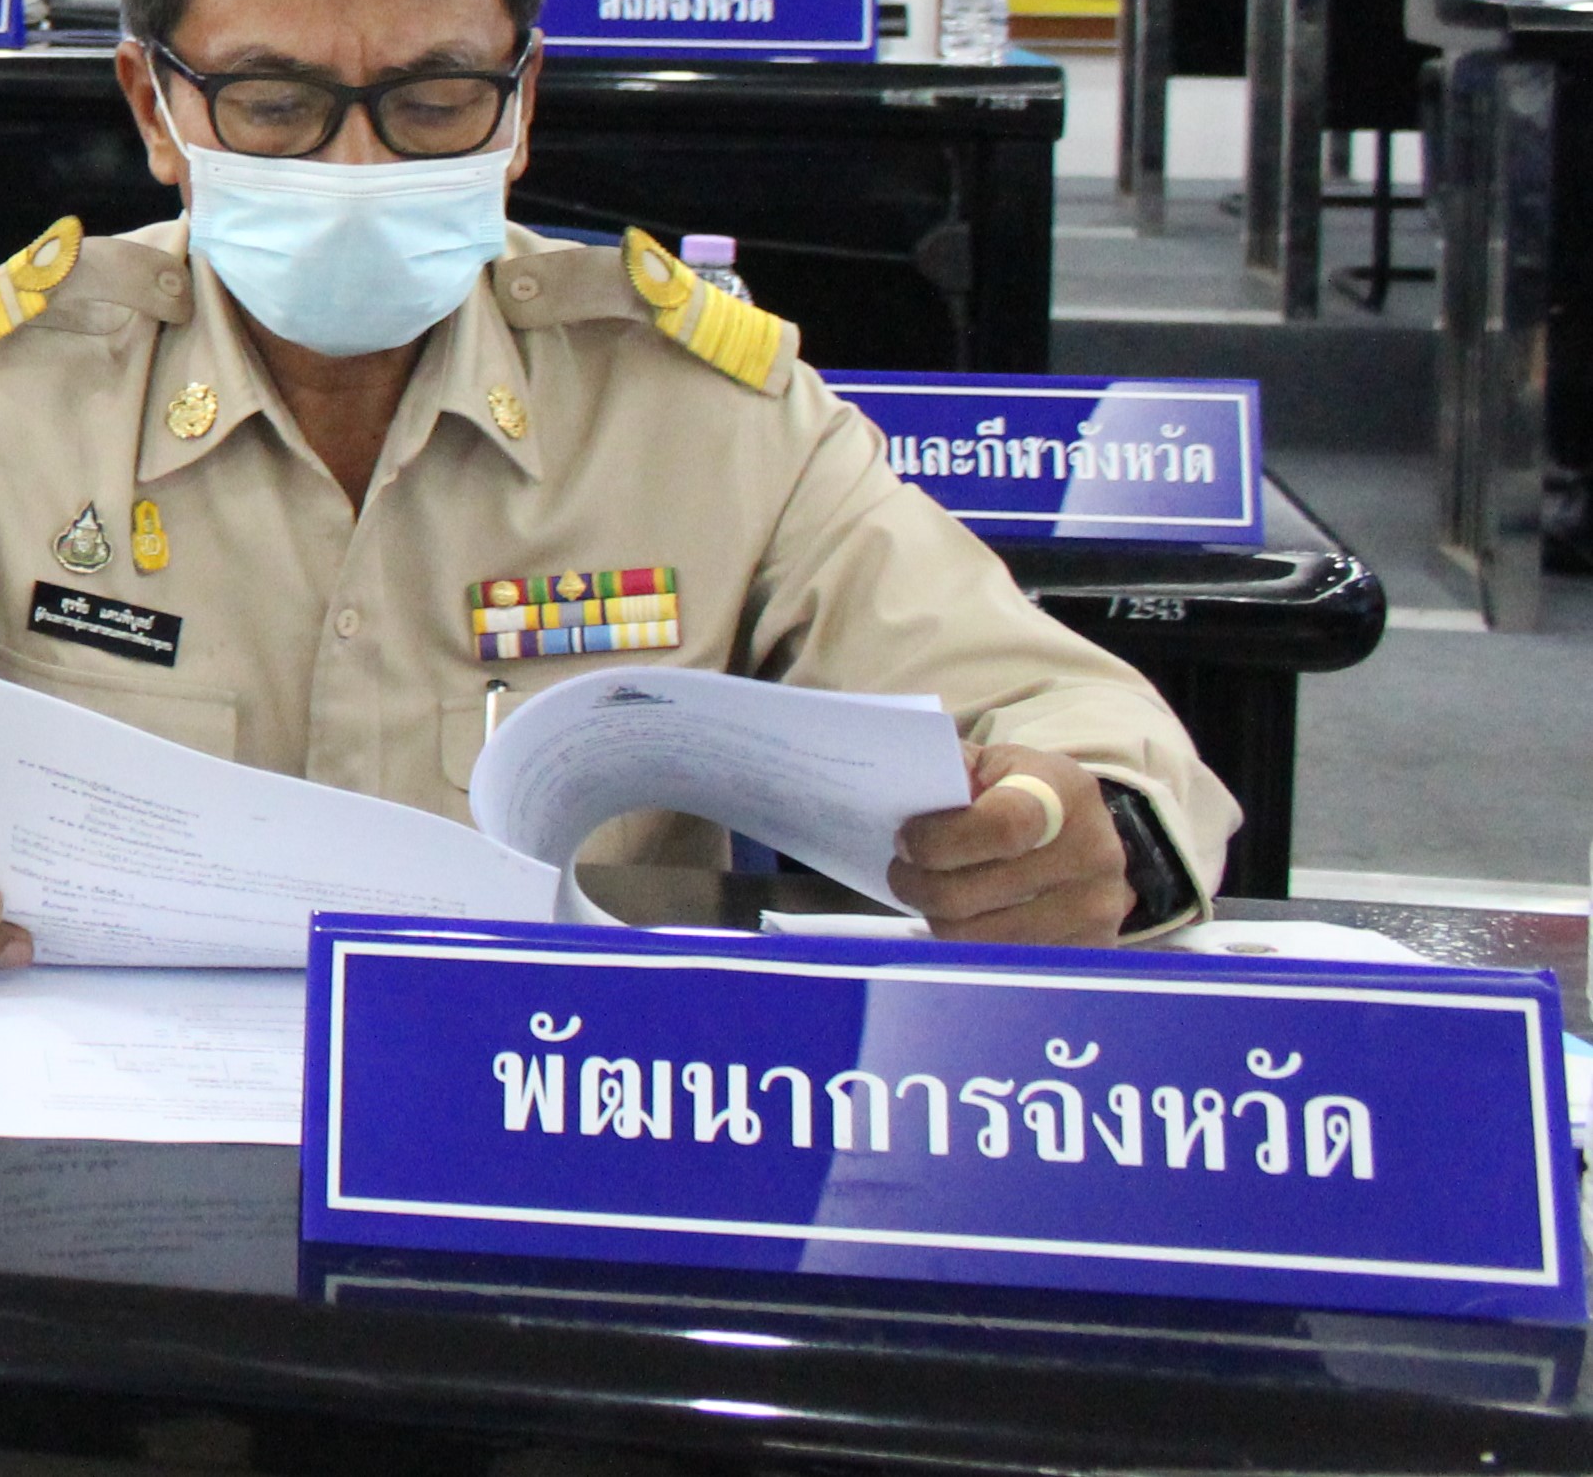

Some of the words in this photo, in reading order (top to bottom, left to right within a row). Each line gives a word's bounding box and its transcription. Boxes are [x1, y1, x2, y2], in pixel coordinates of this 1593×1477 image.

[889, 416, 1216, 484] และกีฬาจังหวัด
[492, 1011, 1375, 1180] พัฒนาการจังหวัด
